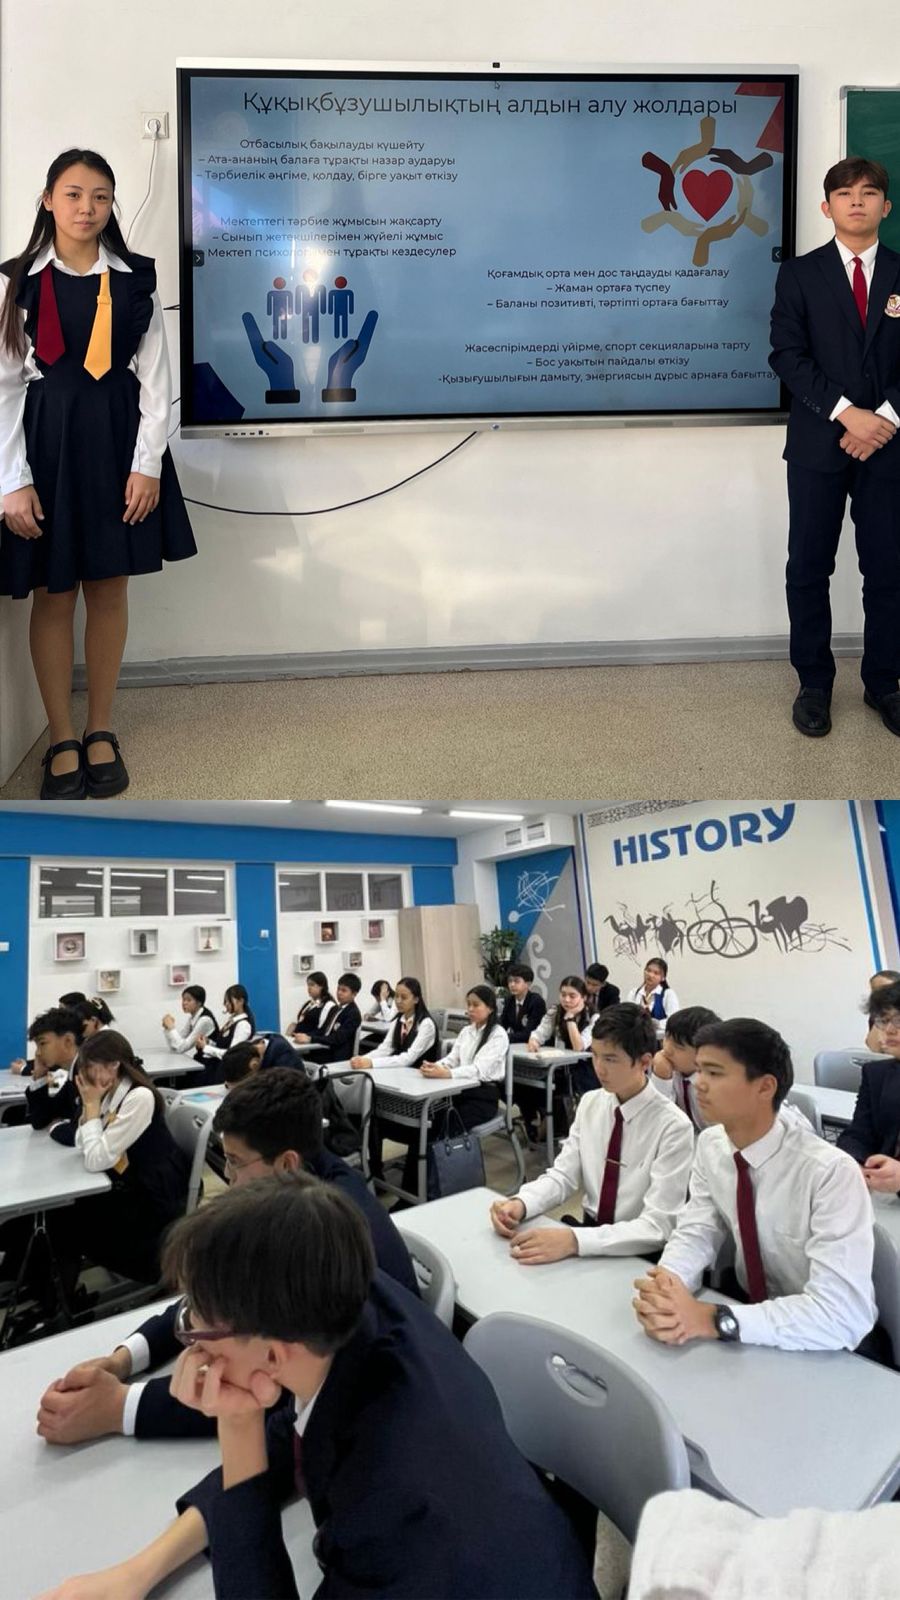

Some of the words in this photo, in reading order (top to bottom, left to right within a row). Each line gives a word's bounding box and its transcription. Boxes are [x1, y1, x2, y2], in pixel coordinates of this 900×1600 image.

[244, 92, 501, 116] Құқықбұзушылықтың
[508, 100, 580, 115] алдын
[588, 100, 626, 117] алу
[633, 99, 737, 117] жолдары
[240, 139, 308, 151] Отбасылық
[310, 139, 373, 151] бақылауды
[377, 140, 424, 152] күшейту
[208, 155, 278, 166] Ата-ананың
[281, 154, 319, 164] балаға
[323, 157, 368, 166] тұрақты
[372, 158, 405, 167] назар
[408, 158, 455, 167] аударуы
[205, 170, 265, 181] Тәрбиелік
[358, 170, 387, 182] бірге
[390, 173, 422, 182] уақыт
[425, 171, 457, 182] өткізу
[221, 216, 284, 226] Мектептегі
[288, 216, 329, 227] тәрбие
[333, 218, 386, 227] жұмысын
[390, 218, 441, 227] жақсарту
[222, 233, 262, 241] Сынып
[364, 232, 402, 243] жүйелі
[406, 233, 443, 242] жұмыс
[208, 249, 251, 257] Мектеп
[343, 249, 388, 258] тұрақты
[392, 249, 456, 257] кездесулер
[488, 269, 544, 280] Қоғамдық
[546, 271, 570, 279] орта
[598, 270, 617, 278] дос
[620, 270, 671, 279] таңдауды
[675, 269, 729, 279] қадағалау
[555, 284, 593, 292] Жаман
[596, 285, 632, 294] ортаға
[635, 285, 670, 294] түспеу
[496, 299, 537, 308] Баланы
[598, 298, 639, 309] тәртіпті
[642, 300, 678, 308] ортаға
[681, 297, 729, 308] бағыттау
[465, 343, 559, 354] Жасөспірімдерді
[605, 344, 637, 352] спорт
[639, 343, 718, 352] секцияларына
[722, 343, 750, 351] тарту
[536, 358, 555, 366] Бос
[558, 359, 604, 368] уақытын
[608, 357, 655, 366] пайдалы
[658, 356, 689, 366] өткізу
[585, 373, 651, 382] энергиясын
[654, 373, 688, 382] дұрыс
[691, 372, 728, 381] арнаға
[613, 803, 796, 866] HISTORY
